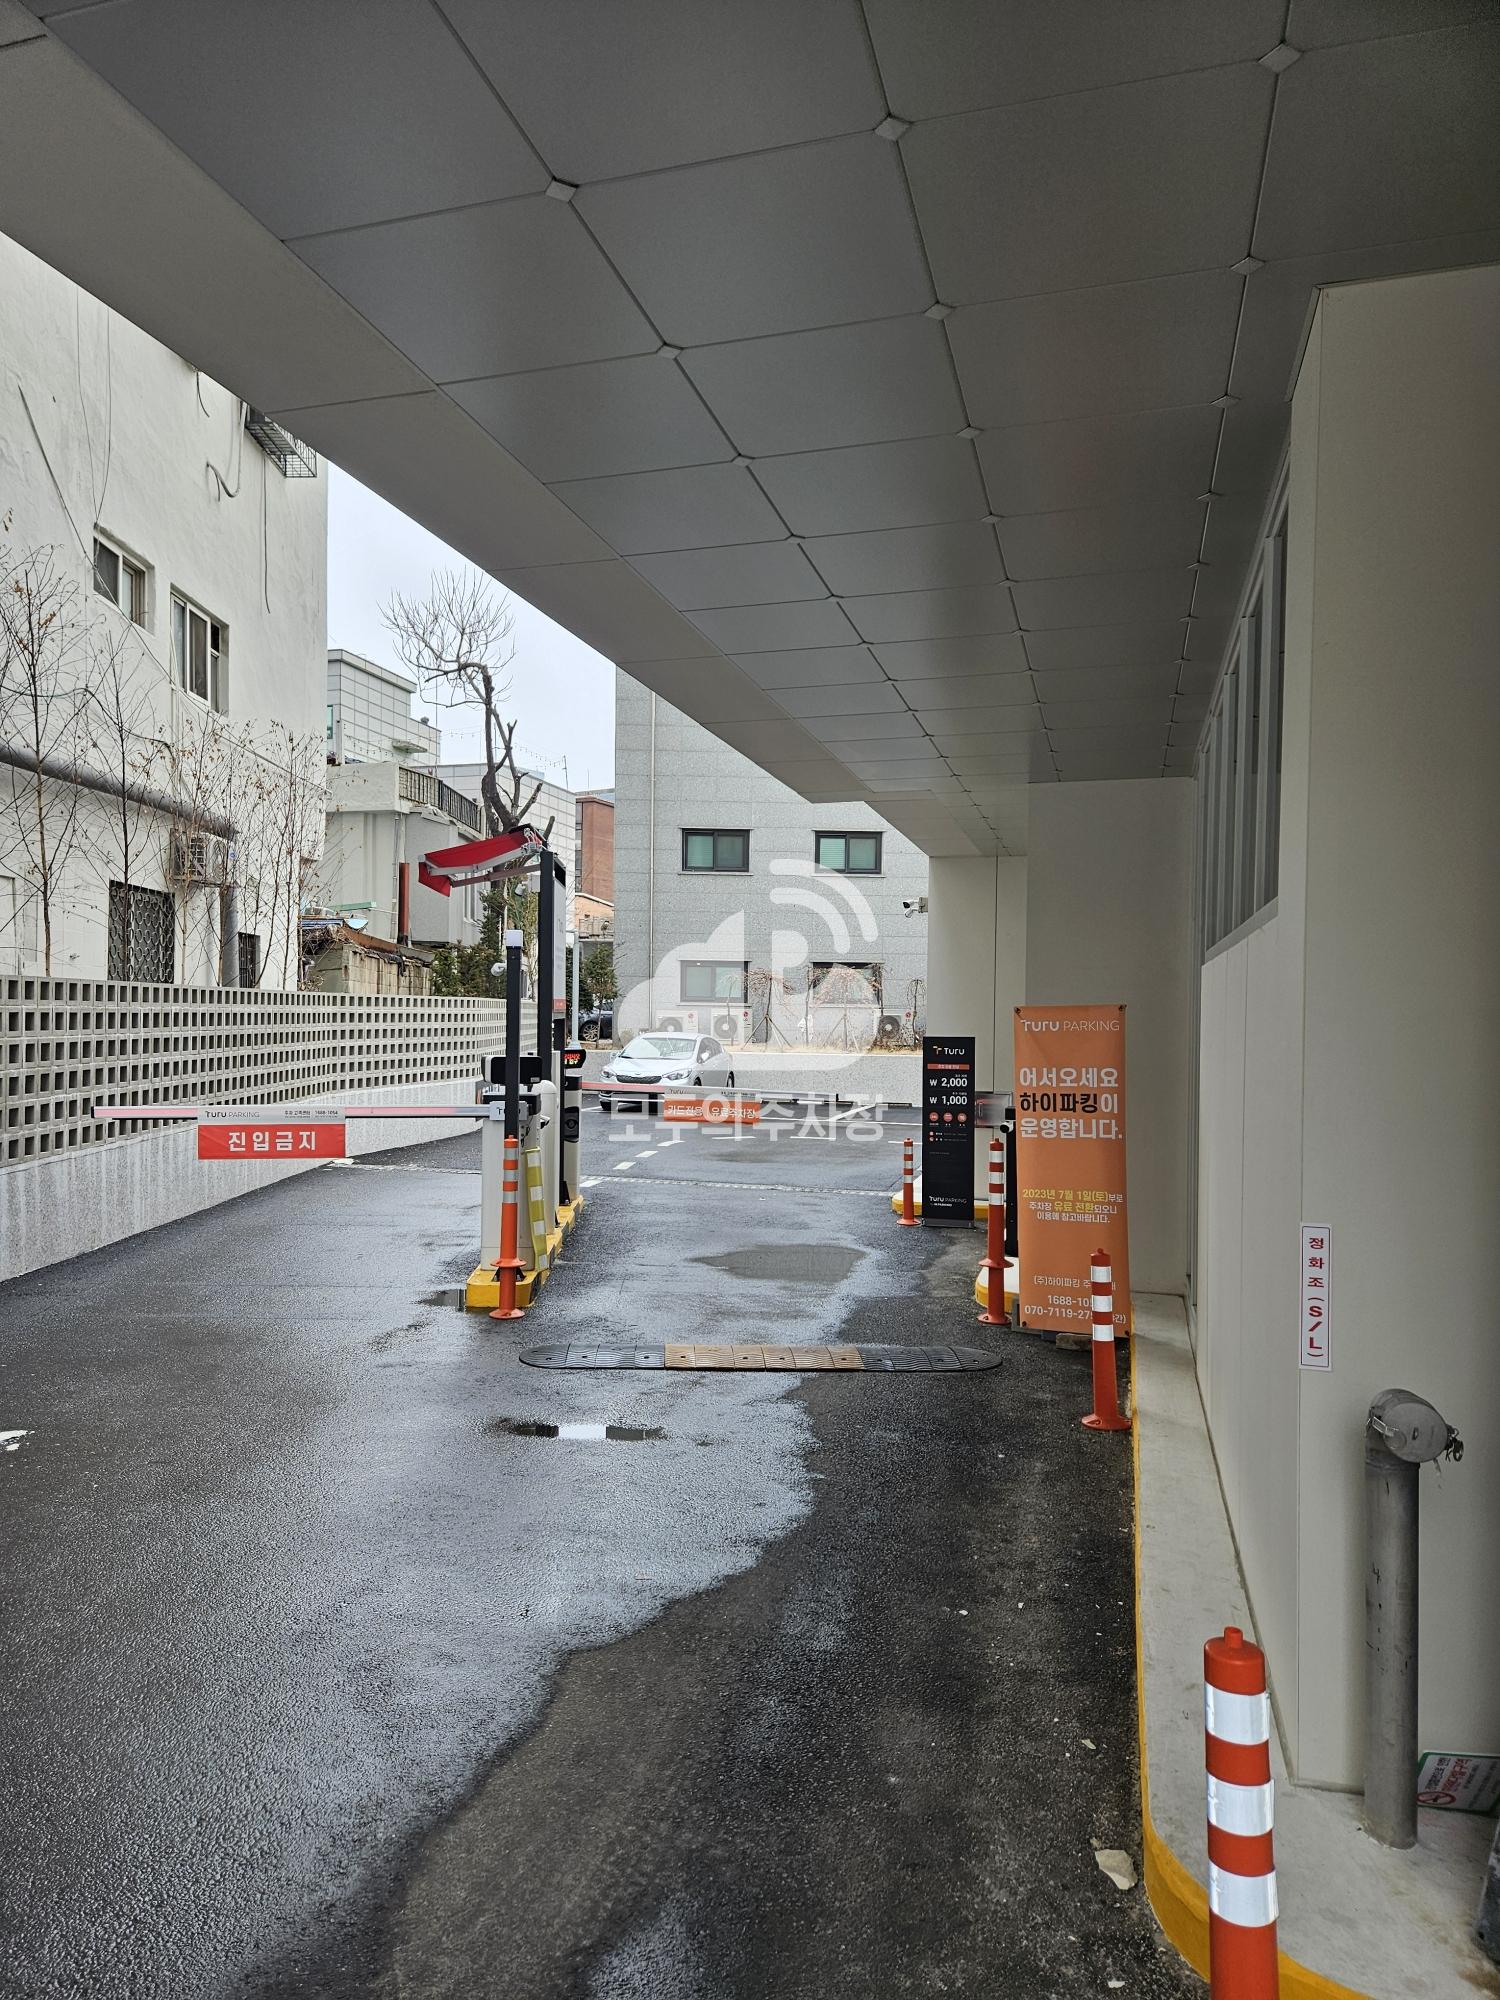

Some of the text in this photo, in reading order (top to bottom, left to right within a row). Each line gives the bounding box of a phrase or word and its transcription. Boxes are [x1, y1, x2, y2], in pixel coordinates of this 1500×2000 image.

[1063, 1020, 1120, 1032] PARKING
[941, 1077, 968, 1088] 2,000
[1019, 1067, 1119, 1089] 어서오세요
[941, 1095, 968, 1106] 1,000
[1019, 1092, 1118, 1114] 하이파킹이
[229, 1110, 260, 1118] PARKING
[667, 1104, 703, 1117] 카드전용
[1020, 1117, 1123, 1140] 운영합니다.
[228, 1130, 317, 1152] 진입금지
[1022, 1189, 1123, 1203] 2023년 7월 1일(토)부로
[1029, 1201, 1117, 1214] 주차장 유료 전환되오니
[1036, 1211, 1110, 1223] 이용에 참고바랍니다.
[1033, 1275, 1080, 1288] (주)하이파킹
